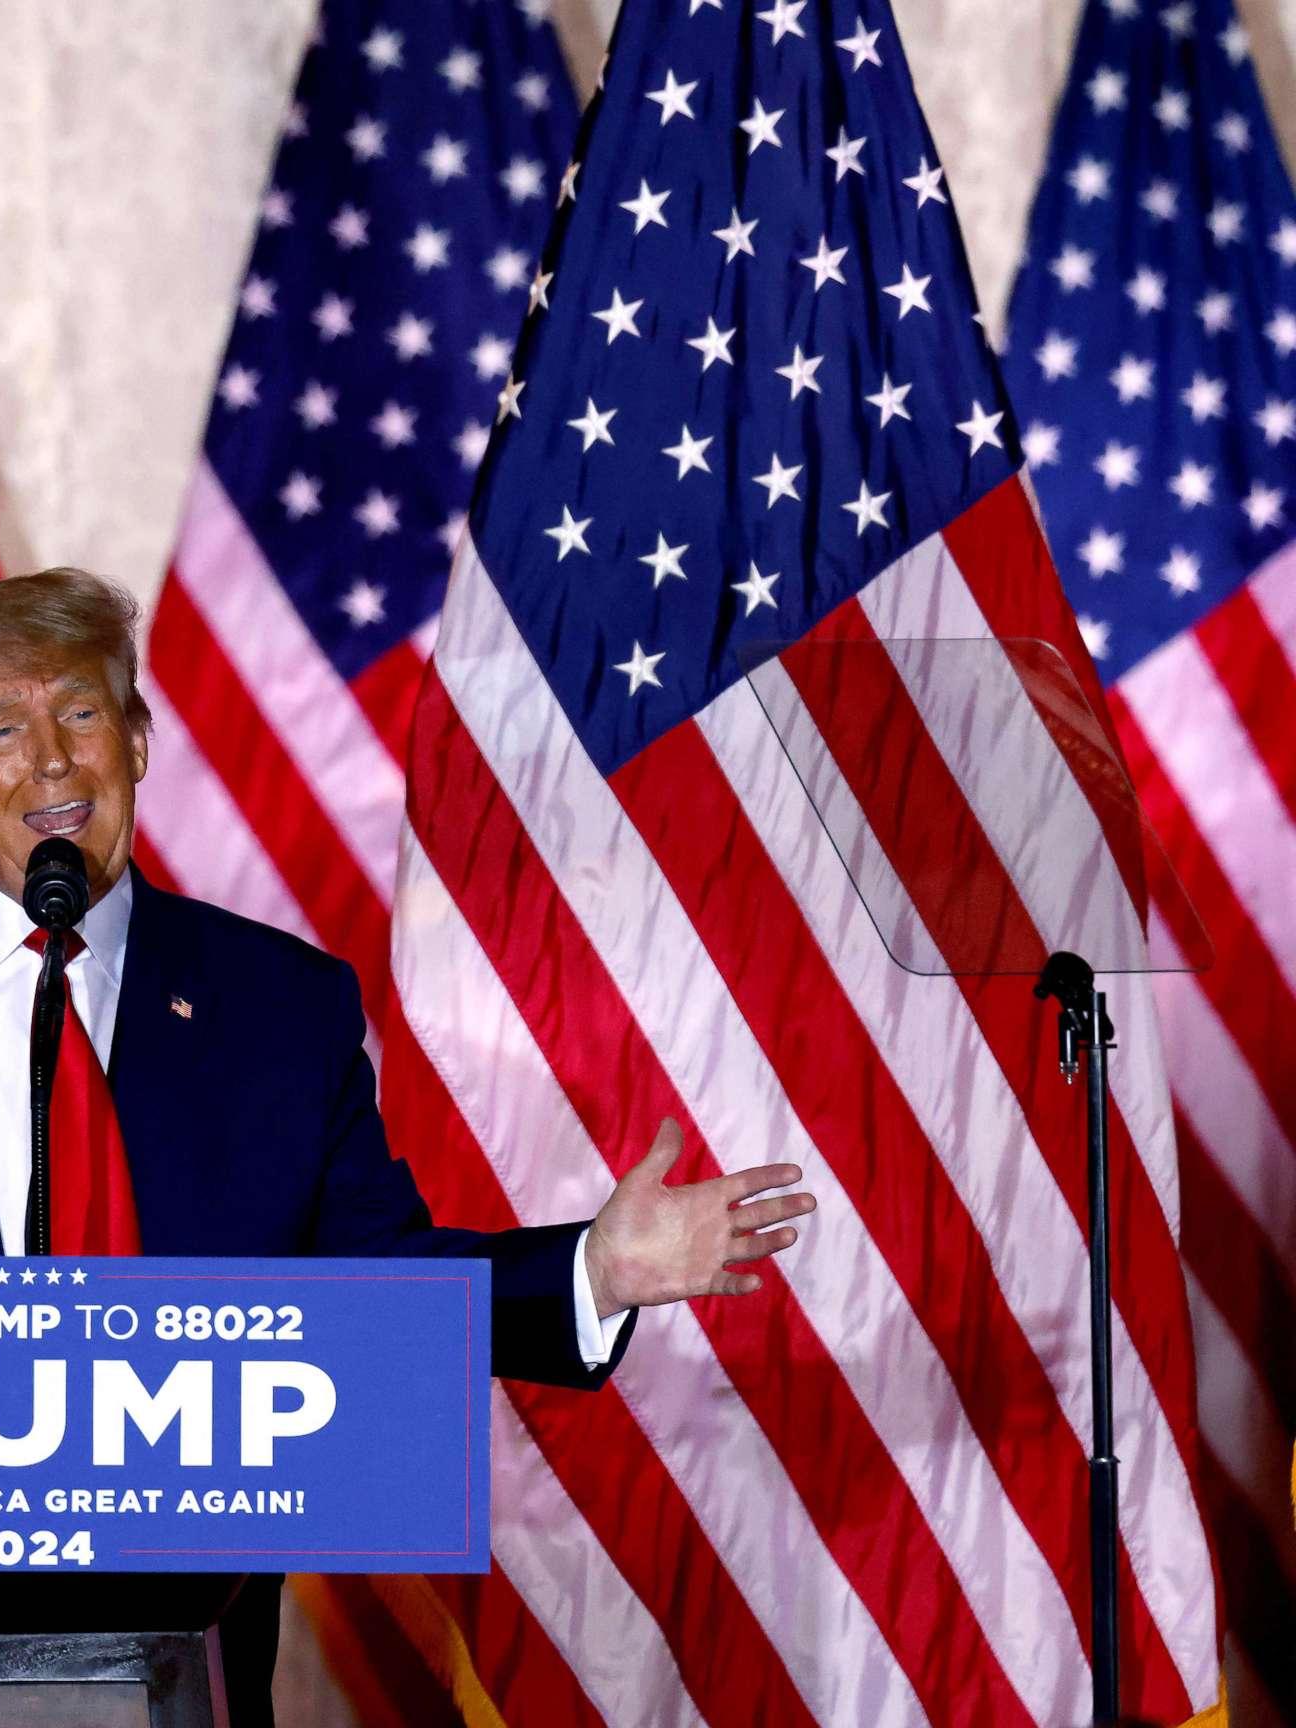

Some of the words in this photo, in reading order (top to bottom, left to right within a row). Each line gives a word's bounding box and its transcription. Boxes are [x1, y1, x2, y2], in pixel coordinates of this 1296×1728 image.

[74, 1304, 139, 1340] TO
[154, 1304, 304, 1341] 88022
[44, 1488, 163, 1513] GREAT
[176, 1489, 305, 1514] AGAIN!
